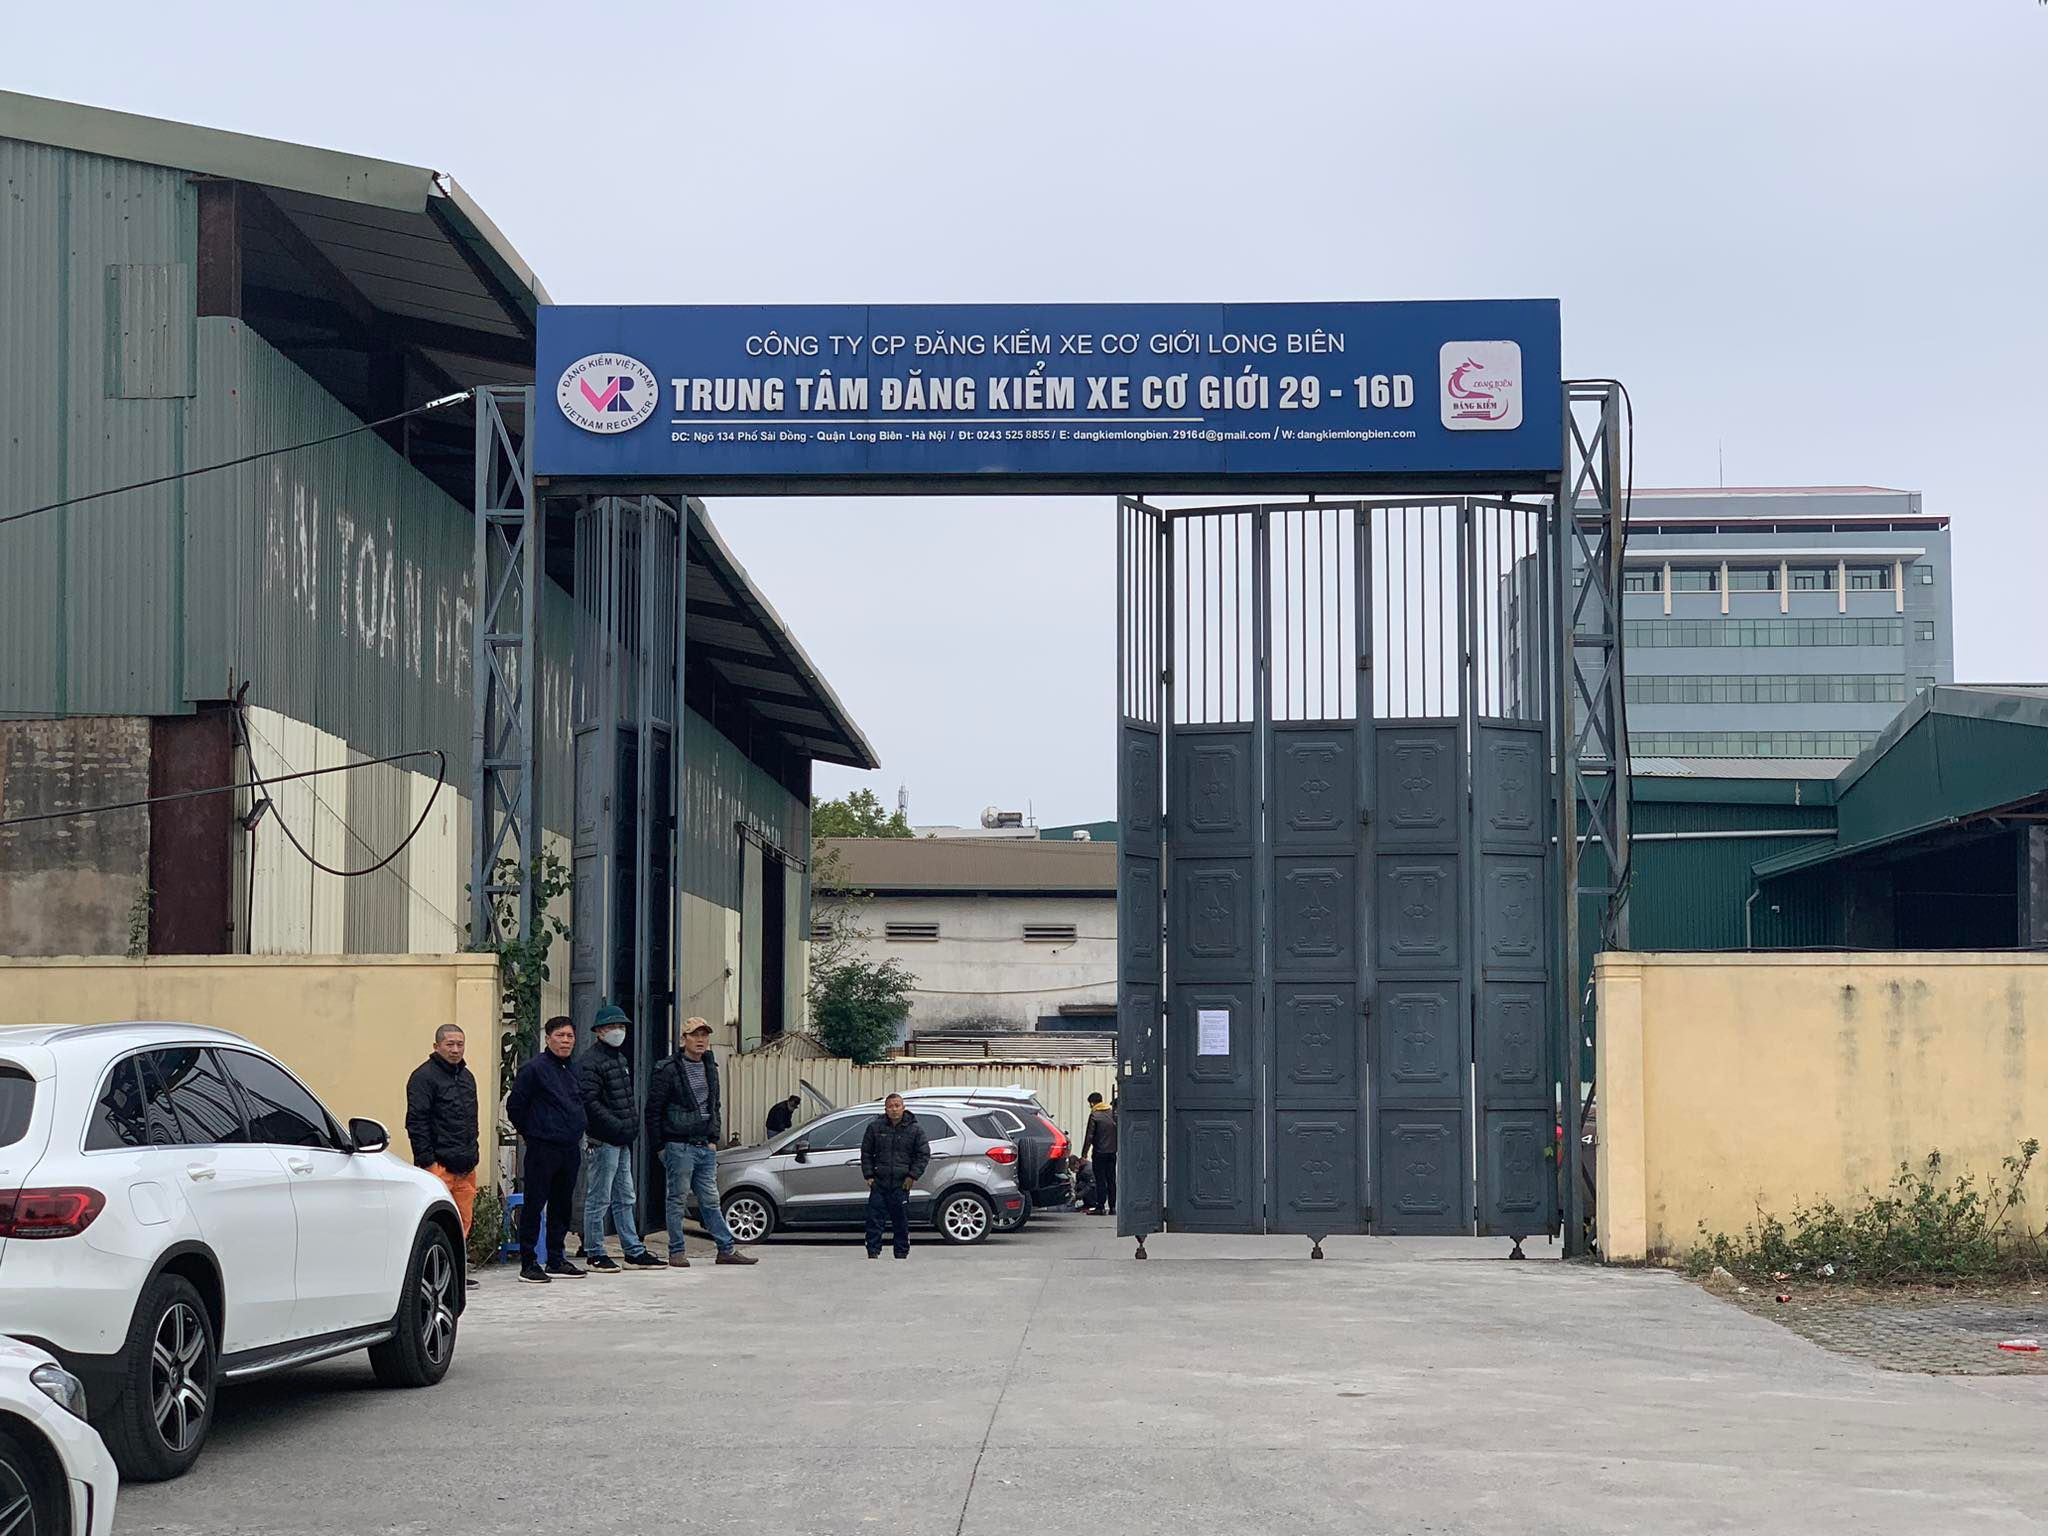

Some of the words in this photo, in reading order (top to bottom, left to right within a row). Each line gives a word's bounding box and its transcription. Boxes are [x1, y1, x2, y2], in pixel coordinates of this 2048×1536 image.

[745, 330, 819, 356] CÔNG
[828, 335, 863, 355] TY
[871, 335, 906, 355] CP
[914, 329, 985, 355] ĐĂNG
[1059, 334, 1093, 354] XE
[1101, 333, 1140, 354] CƠ
[1149, 329, 1200, 354] GIỚI
[1209, 333, 1277, 354] LONG
[1287, 328, 1345, 353] BIÊN
[615, 358, 637, 370] VIỆT
[637, 367, 654, 388] NAM
[671, 377, 784, 412] TRUNG
[795, 368, 868, 411] TÂM
[880, 368, 975, 410] ĐĂNG
[989, 361, 1075, 410] KIỂM
[1086, 376, 1129, 410] XE
[1142, 373, 1188, 409] CƠ
[1199, 364, 1269, 409] GIỚI
[1279, 375, 1320, 409] 29
[1330, 388, 1342, 397] -
[1353, 374, 1414, 408] 16D
[563, 402, 603, 430] VIETNAM
[606, 400, 653, 430] REGISTER
[671, 431, 690, 442] ĐC:
[717, 431, 735, 442] 134
[737, 429, 758, 442] Phố
[779, 429, 807, 443] Đồng
[816, 431, 846, 443] Quận
[849, 431, 877, 443] Long
[879, 430, 903, 442] Biên
[911, 429, 926, 441] Hà
[928, 430, 946, 442] Nội
[958, 430, 974, 441] Đt:
[976, 430, 1002, 441] 0243
[1005, 430, 1024, 441] 525
[1025, 430, 1050, 441] 8855
[1059, 430, 1070, 441] E:
[1281, 430, 1295, 440] W:
[1297, 429, 1416, 443] dangkiemlongbien.com
